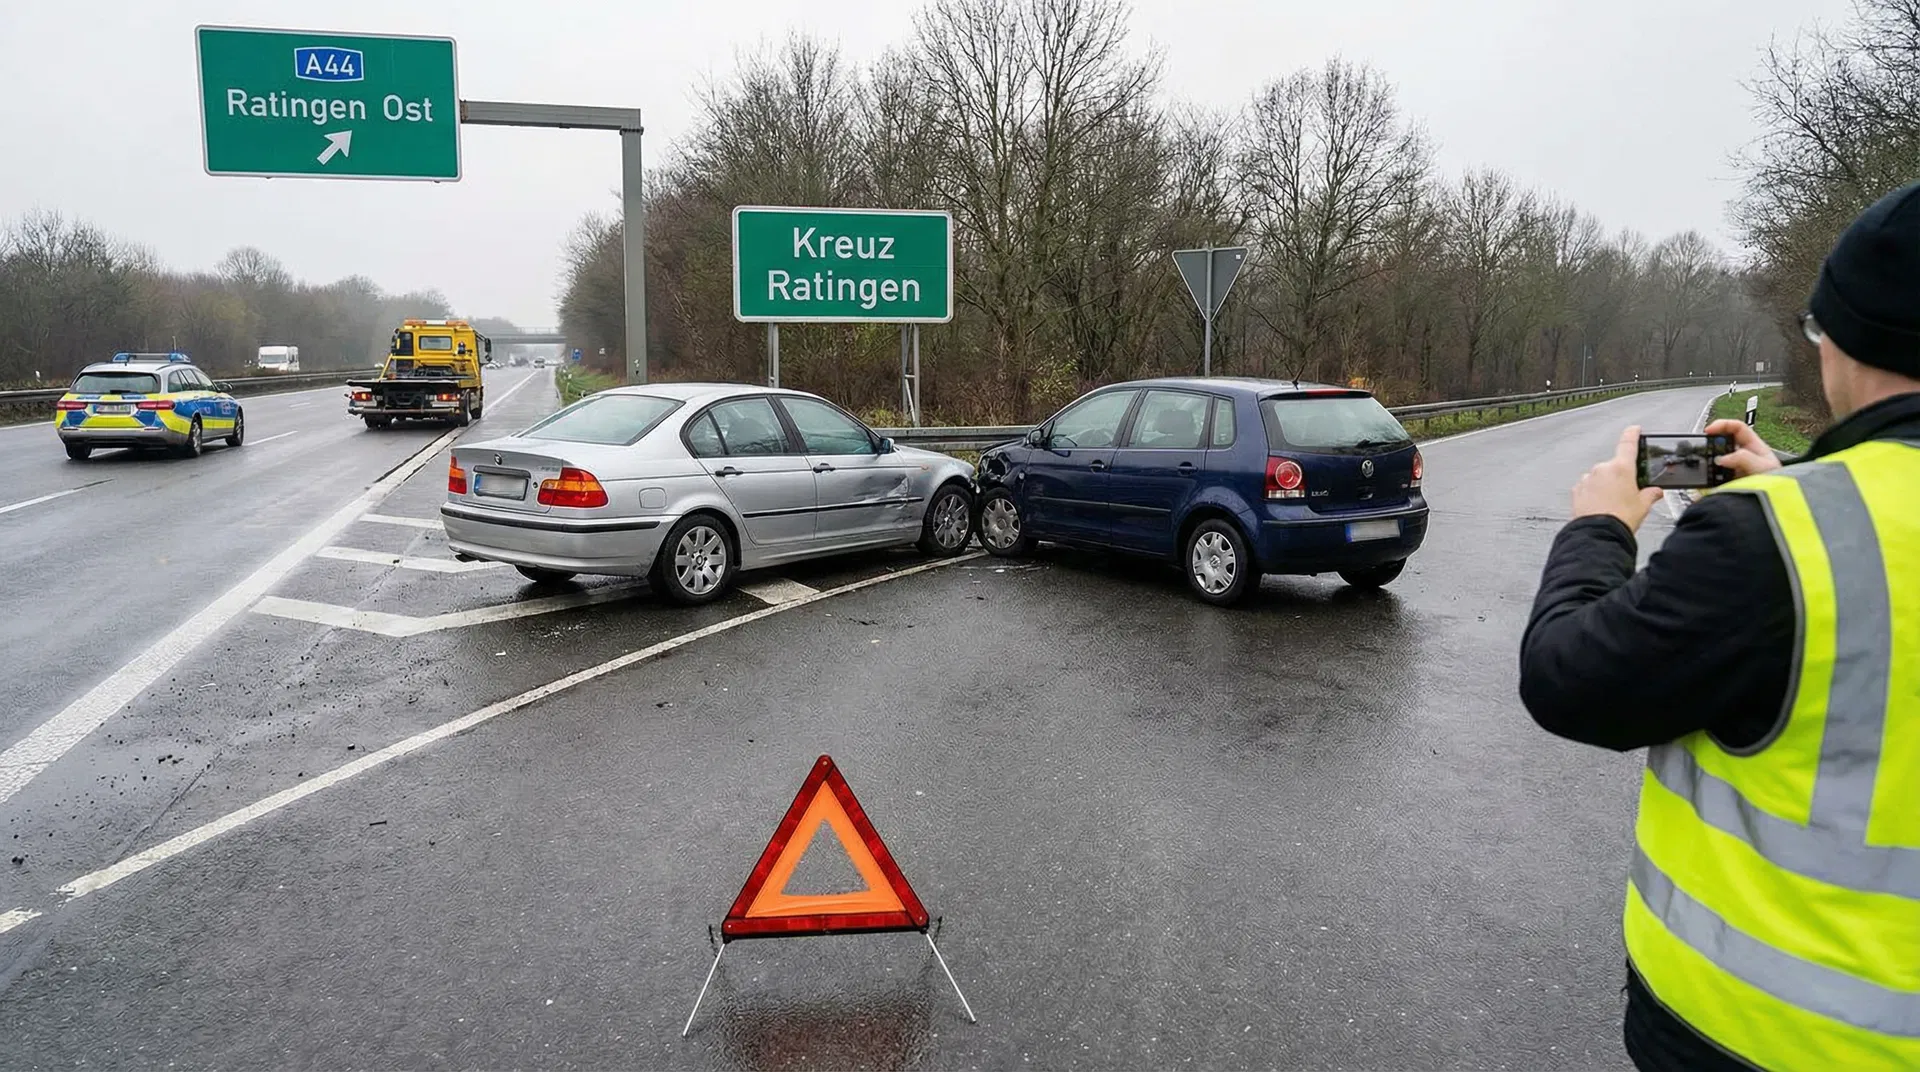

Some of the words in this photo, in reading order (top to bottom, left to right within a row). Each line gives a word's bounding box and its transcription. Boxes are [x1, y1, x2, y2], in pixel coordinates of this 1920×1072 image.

[305, 53, 355, 77] A44
[227, 88, 366, 125] Ratingen
[383, 94, 433, 122] Ost
[793, 227, 895, 259] Kreuz
[768, 270, 920, 310] Ratingen
